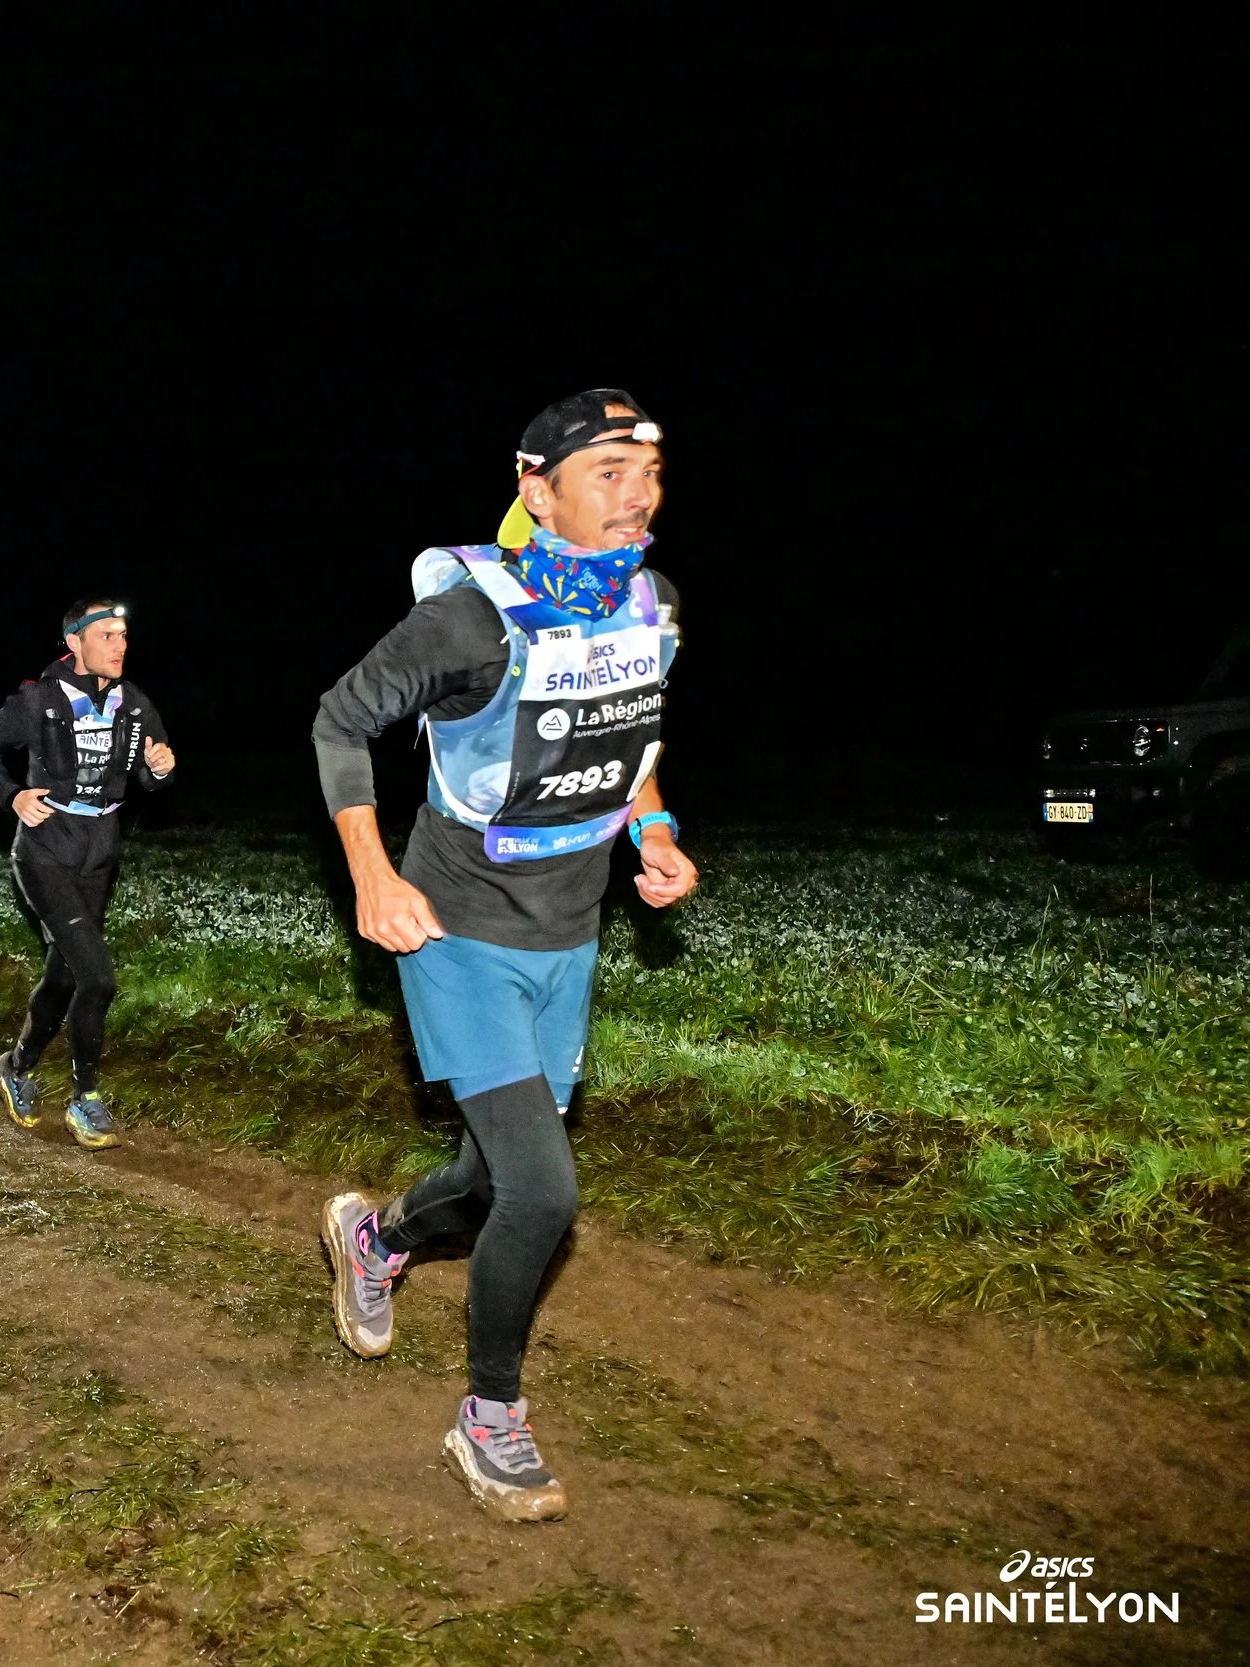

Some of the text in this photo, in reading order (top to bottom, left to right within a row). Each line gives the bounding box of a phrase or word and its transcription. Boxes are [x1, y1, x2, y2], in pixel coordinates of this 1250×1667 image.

[547, 629, 572, 640] 7893
[575, 693, 662, 727] La Région
[536, 760, 624, 801] 7893
[513, 843, 539, 852] LYON
